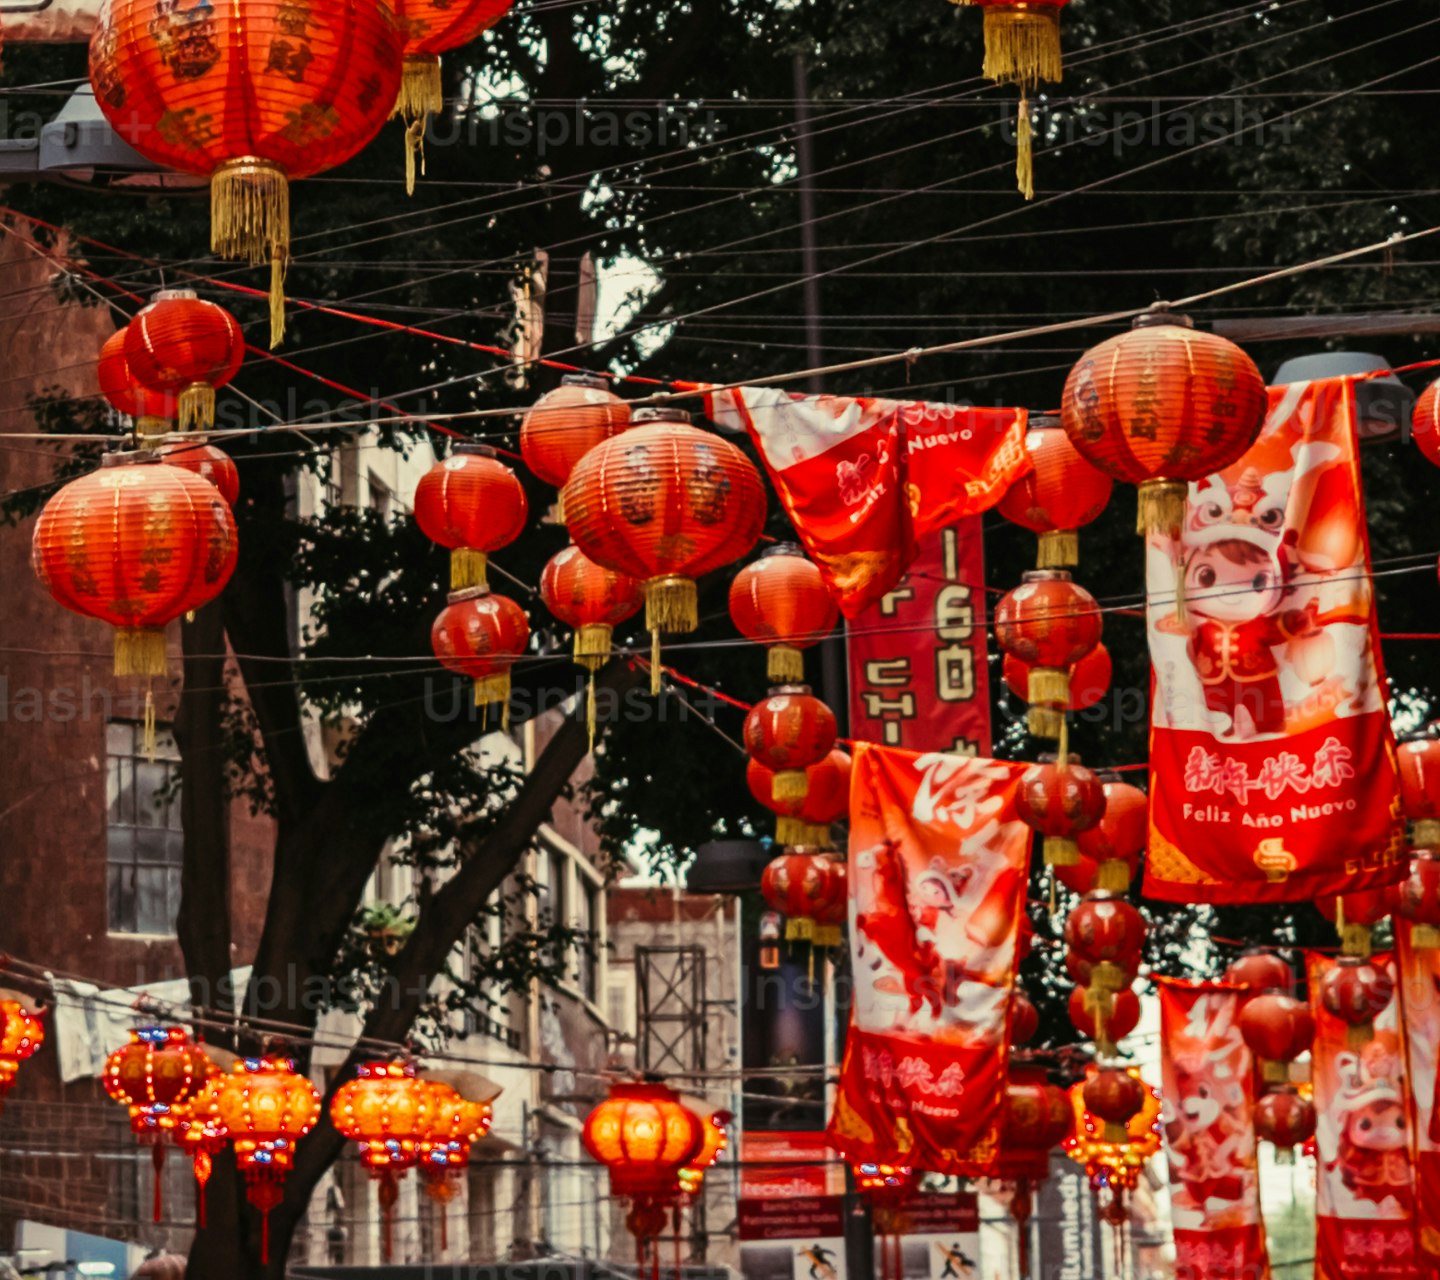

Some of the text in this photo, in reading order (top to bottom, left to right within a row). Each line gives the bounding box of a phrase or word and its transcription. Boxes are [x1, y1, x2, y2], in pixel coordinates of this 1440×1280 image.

[907, 427, 974, 455] Nuevo
[1182, 798, 1358, 829] Feliz Año Nuevo
